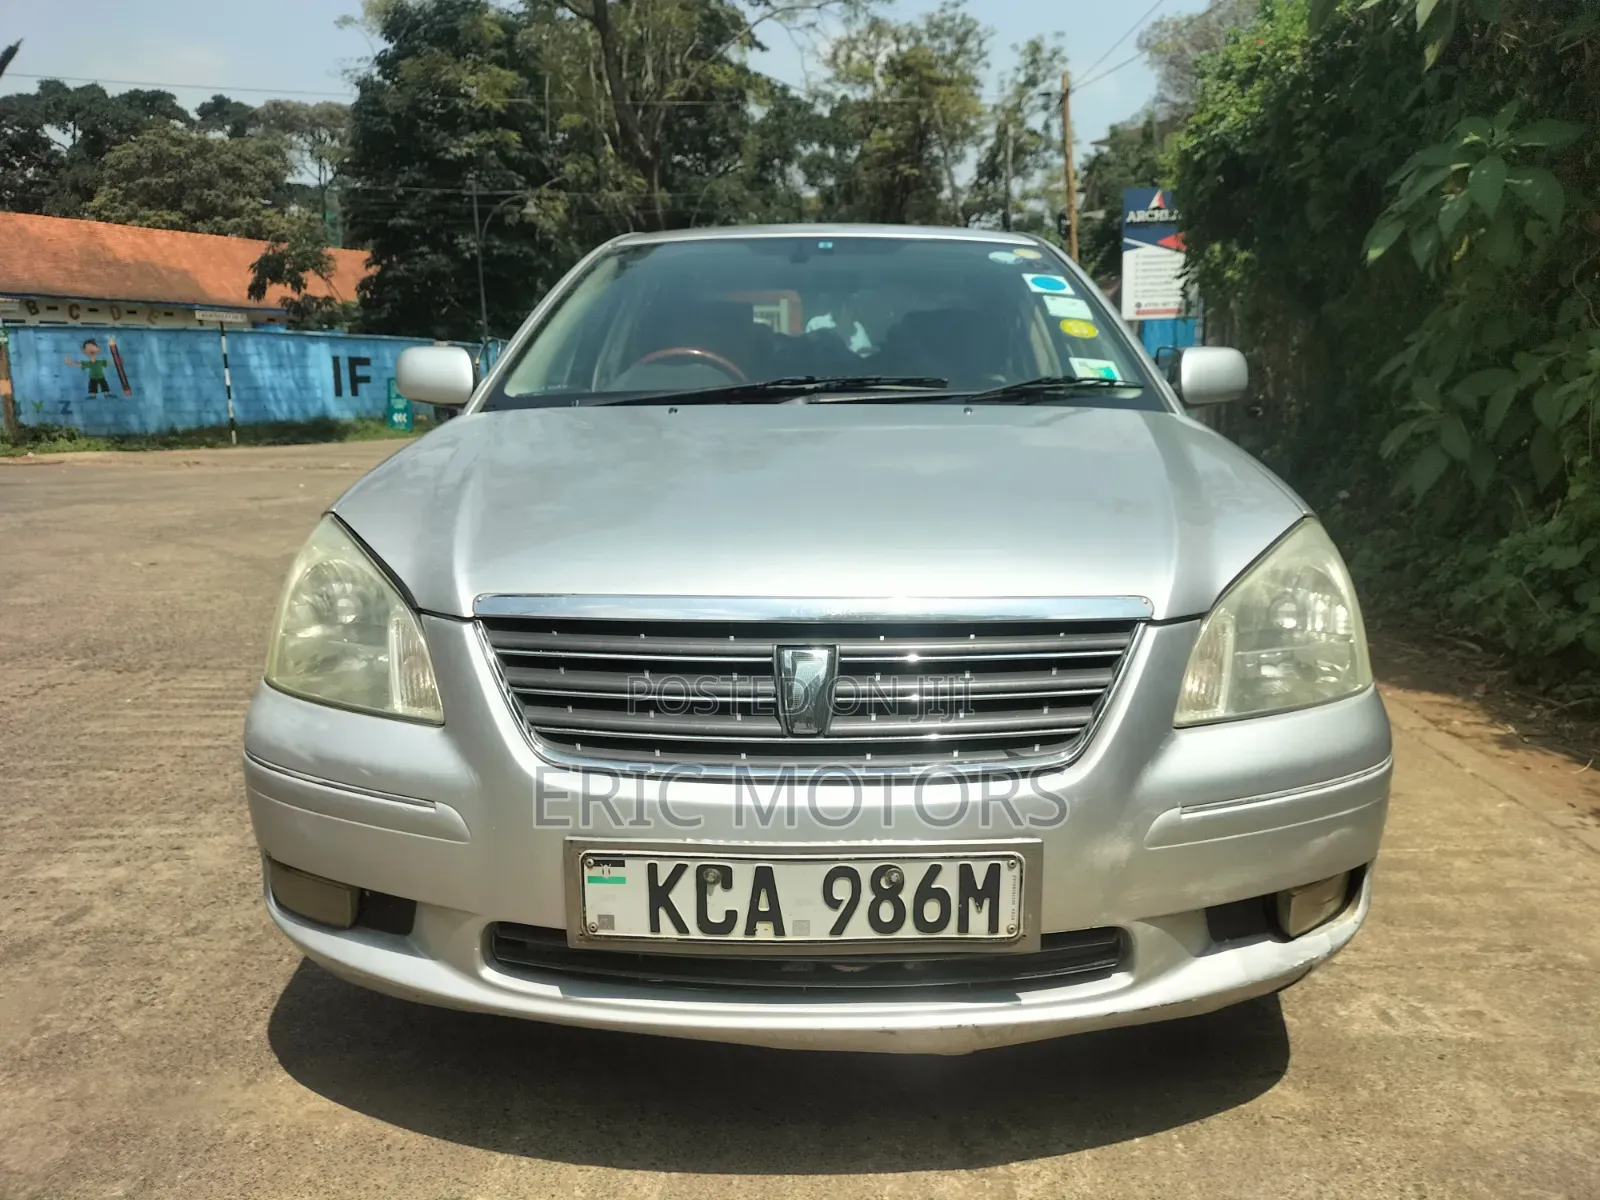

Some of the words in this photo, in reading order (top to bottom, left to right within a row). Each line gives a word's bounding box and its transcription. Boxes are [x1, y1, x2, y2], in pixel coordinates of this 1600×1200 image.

[25, 300, 39, 316] B
[68, 303, 80, 320] C
[332, 355, 371, 397] IF
[59, 400, 73, 414] Z
[647, 862, 786, 937] KCA
[823, 863, 1001, 936] 986M
